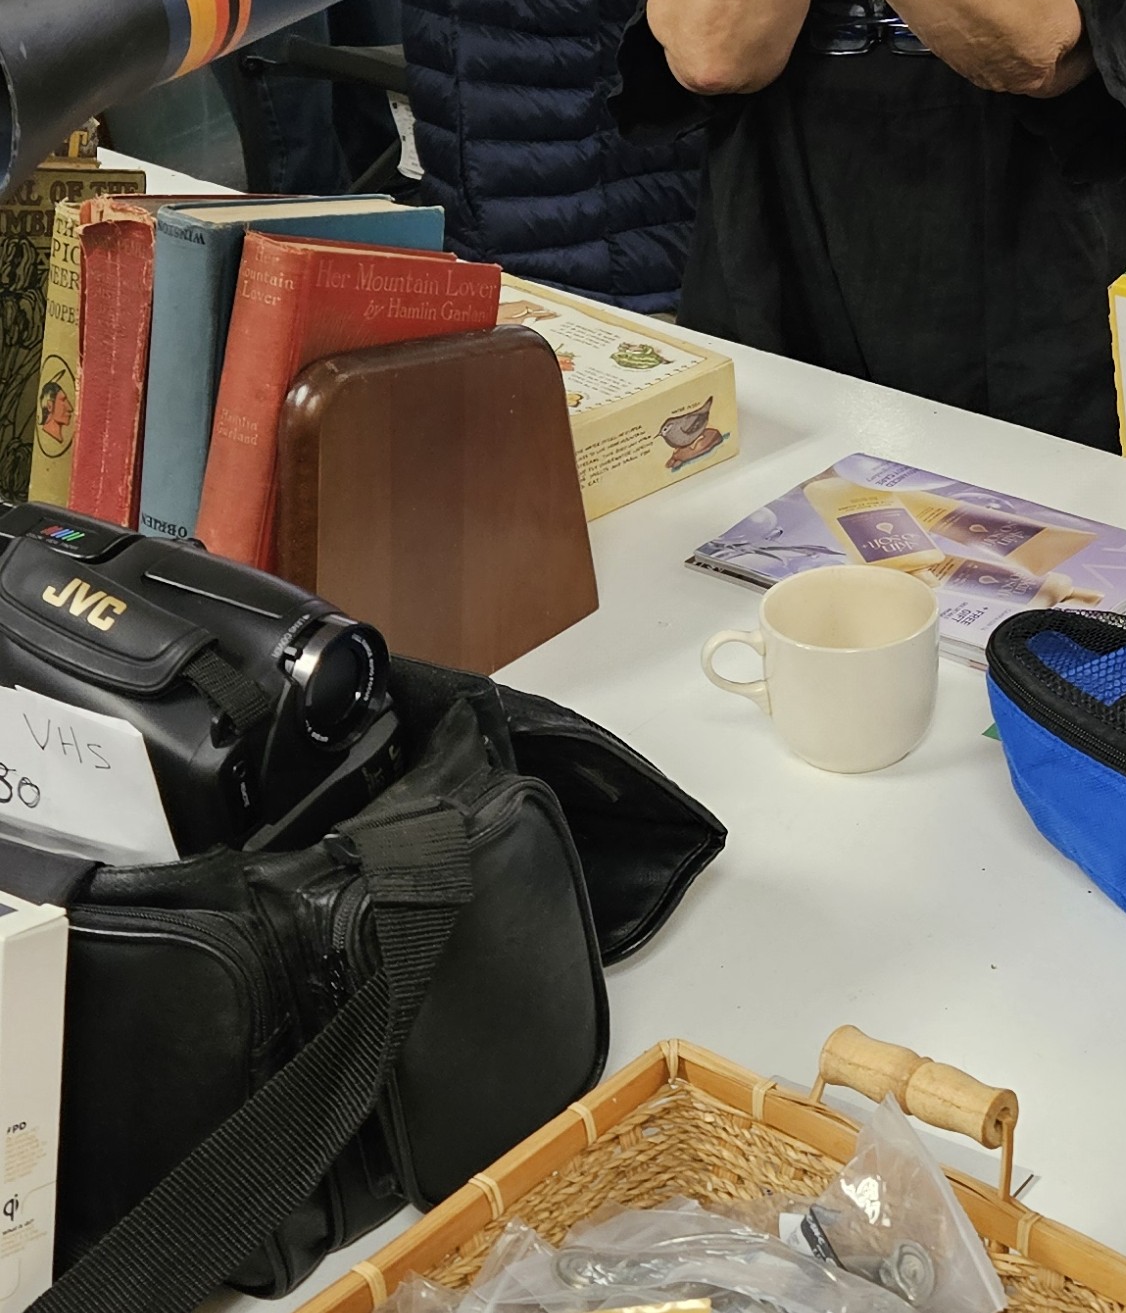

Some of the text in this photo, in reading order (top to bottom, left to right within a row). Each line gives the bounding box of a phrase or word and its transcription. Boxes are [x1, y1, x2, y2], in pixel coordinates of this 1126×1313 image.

[50, 180, 84, 205] OF
[240, 281, 282, 306] Lover
[316, 259, 498, 300] Her Mountain Lover
[47, 297, 79, 325] OOPE
[363, 297, 495, 324] by Hamlin Garland
[42, 577, 128, 631] JVC
[23, 712, 111, 769] VHS
